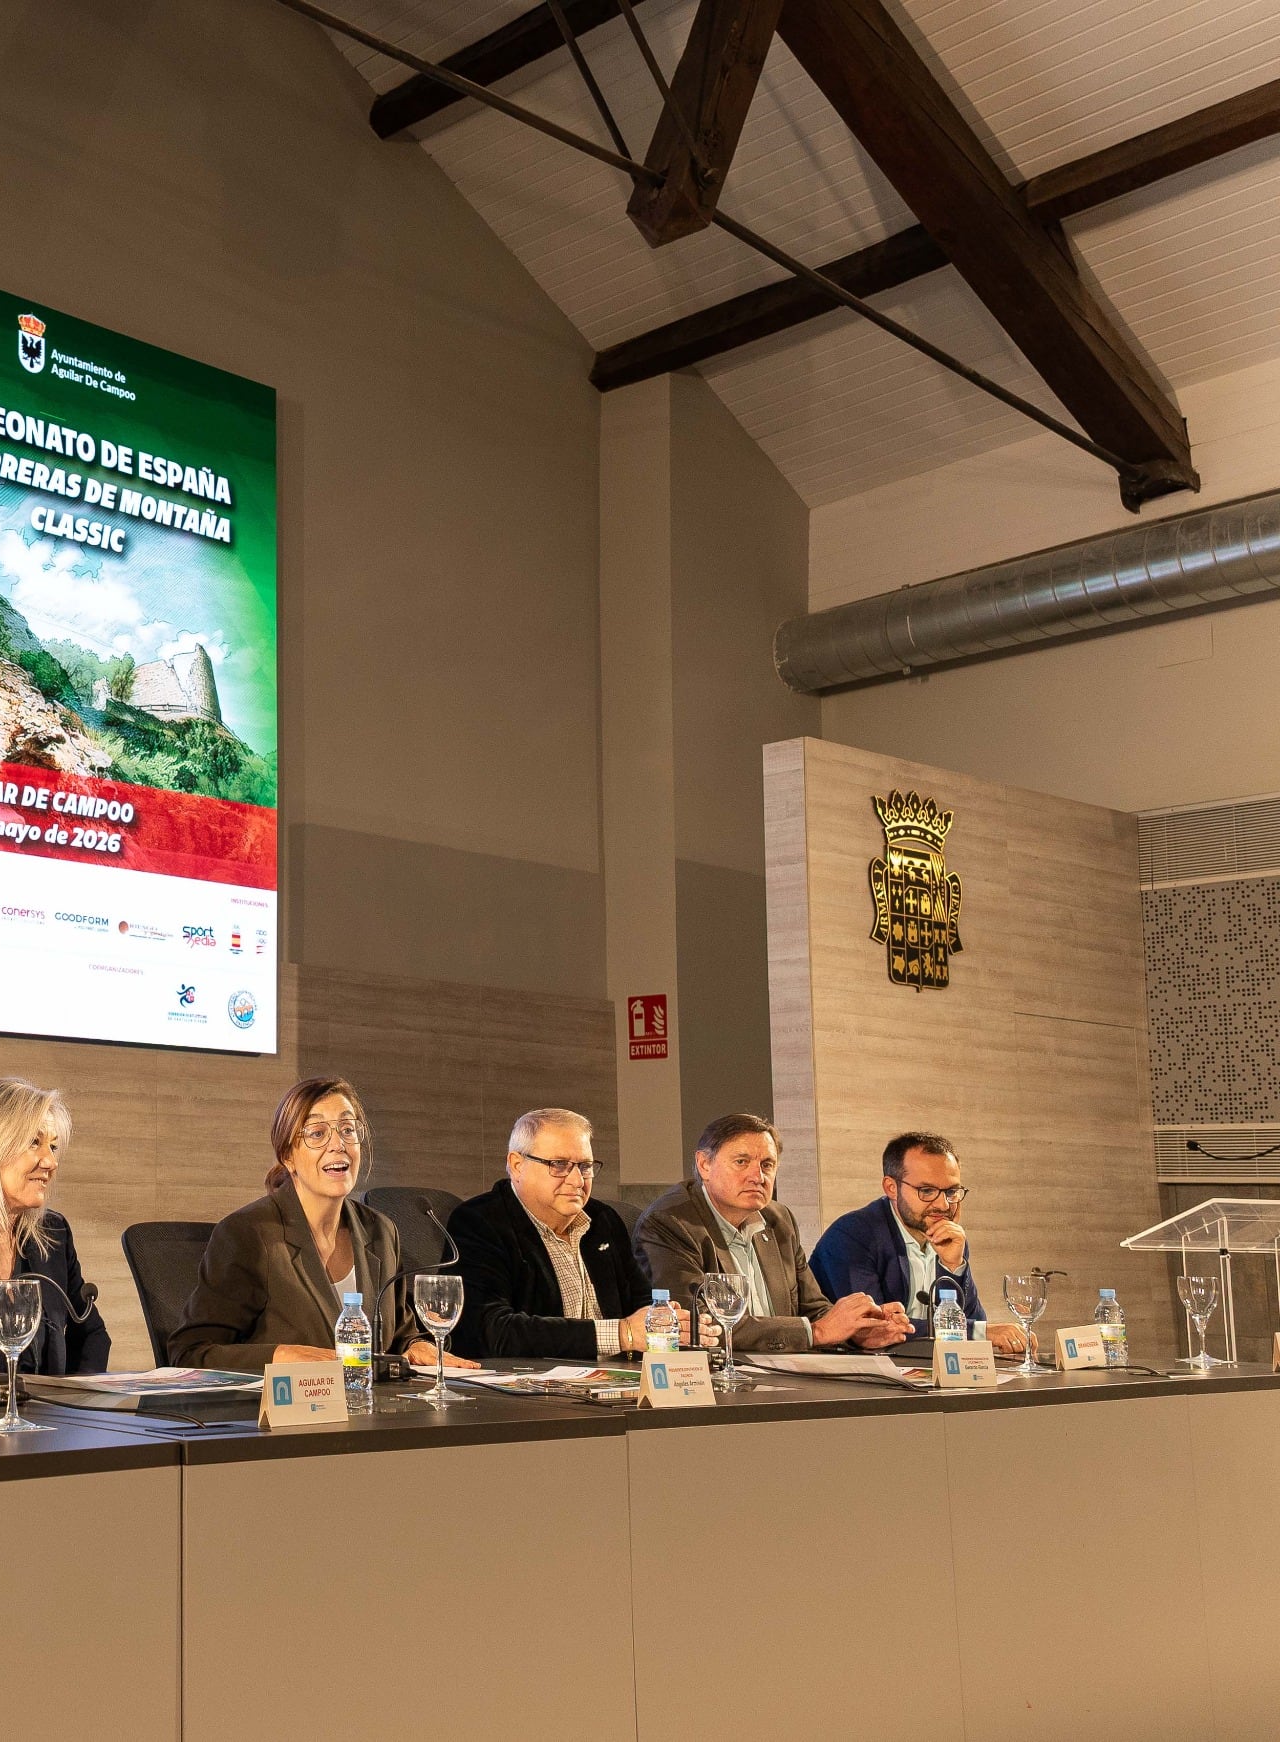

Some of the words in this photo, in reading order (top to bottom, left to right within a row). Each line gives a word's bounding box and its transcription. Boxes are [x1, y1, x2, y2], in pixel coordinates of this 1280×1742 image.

[51, 348, 111, 380] Ayuntamiento
[113, 370, 127, 384] de
[51, 363, 83, 388] Aguilar
[86, 374, 99, 389] De
[100, 377, 136, 401] Campoo
[101, 438, 133, 473] DE
[139, 447, 231, 505] ESPAÑA
[30, 506, 126, 553] CLASSIC
[86, 478, 115, 508] DE
[120, 487, 231, 544] MONTAÑA
[21, 786, 49, 809] DE
[52, 791, 134, 824] CAMPOO
[44, 820, 68, 843] de
[69, 826, 121, 854] 2026
[874, 865, 883, 875] Y
[55, 912, 109, 926] GOODFORM
[875, 882, 889, 938] ARMAS
[949, 882, 960, 944] CIENCIA
[631, 1043, 667, 1056] EXTINTOR
[299, 1377, 325, 1387] AGUILAR
[326, 1377, 335, 1385] DE
[304, 1388, 331, 1398] CAMPOO
